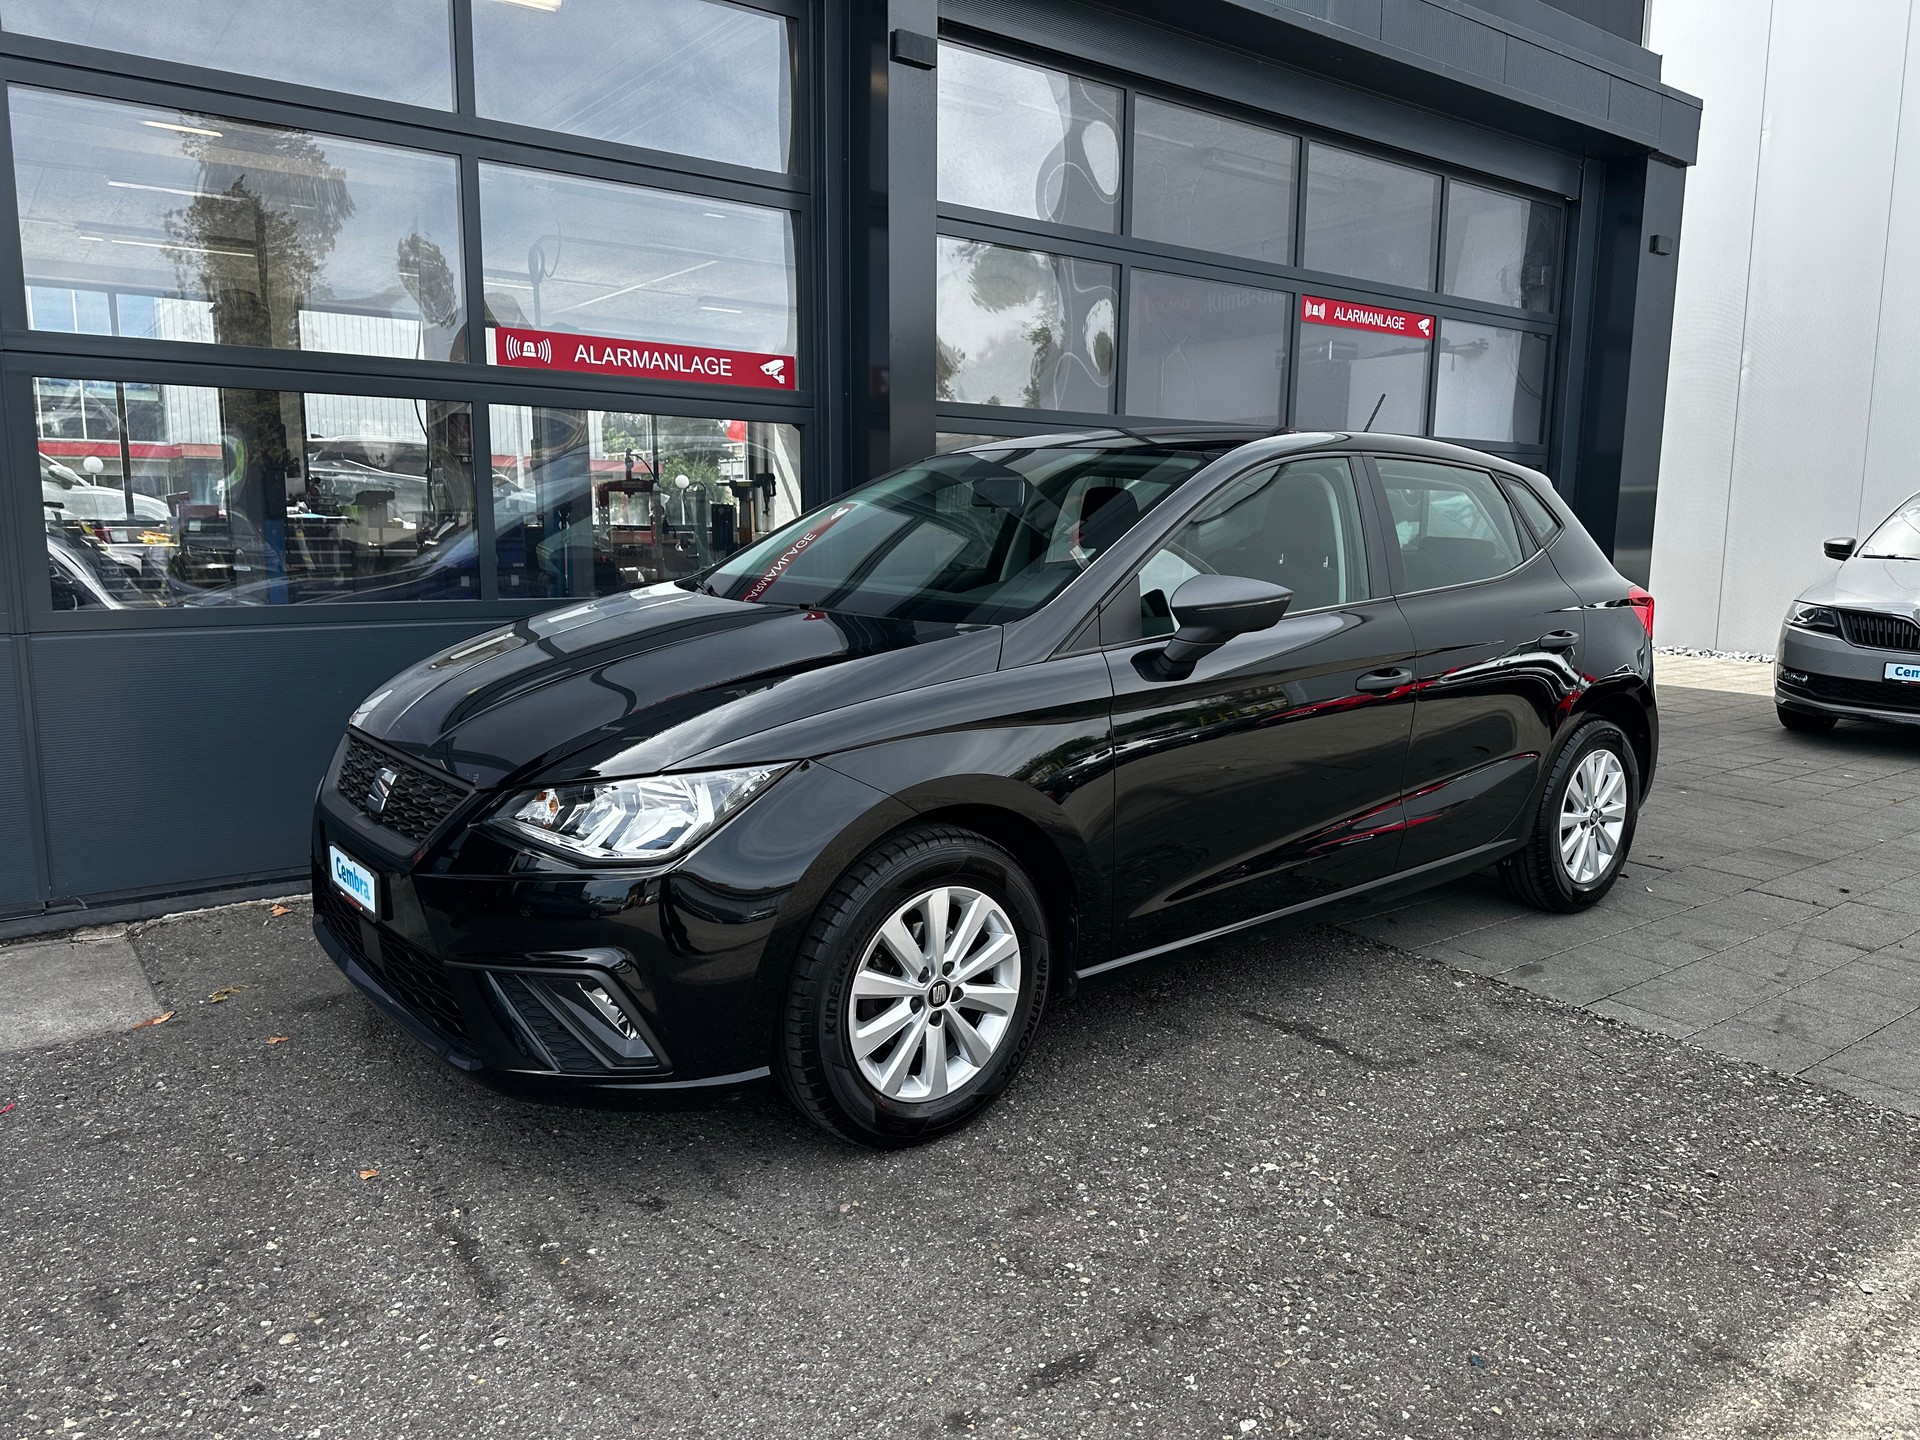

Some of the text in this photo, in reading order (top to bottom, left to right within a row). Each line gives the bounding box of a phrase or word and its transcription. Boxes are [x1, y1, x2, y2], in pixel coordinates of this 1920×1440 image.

[1334, 306, 1405, 330] ALARMANLAGE
[574, 344, 733, 377] ALARMANLAGE
[335, 856, 371, 901] Cembra
